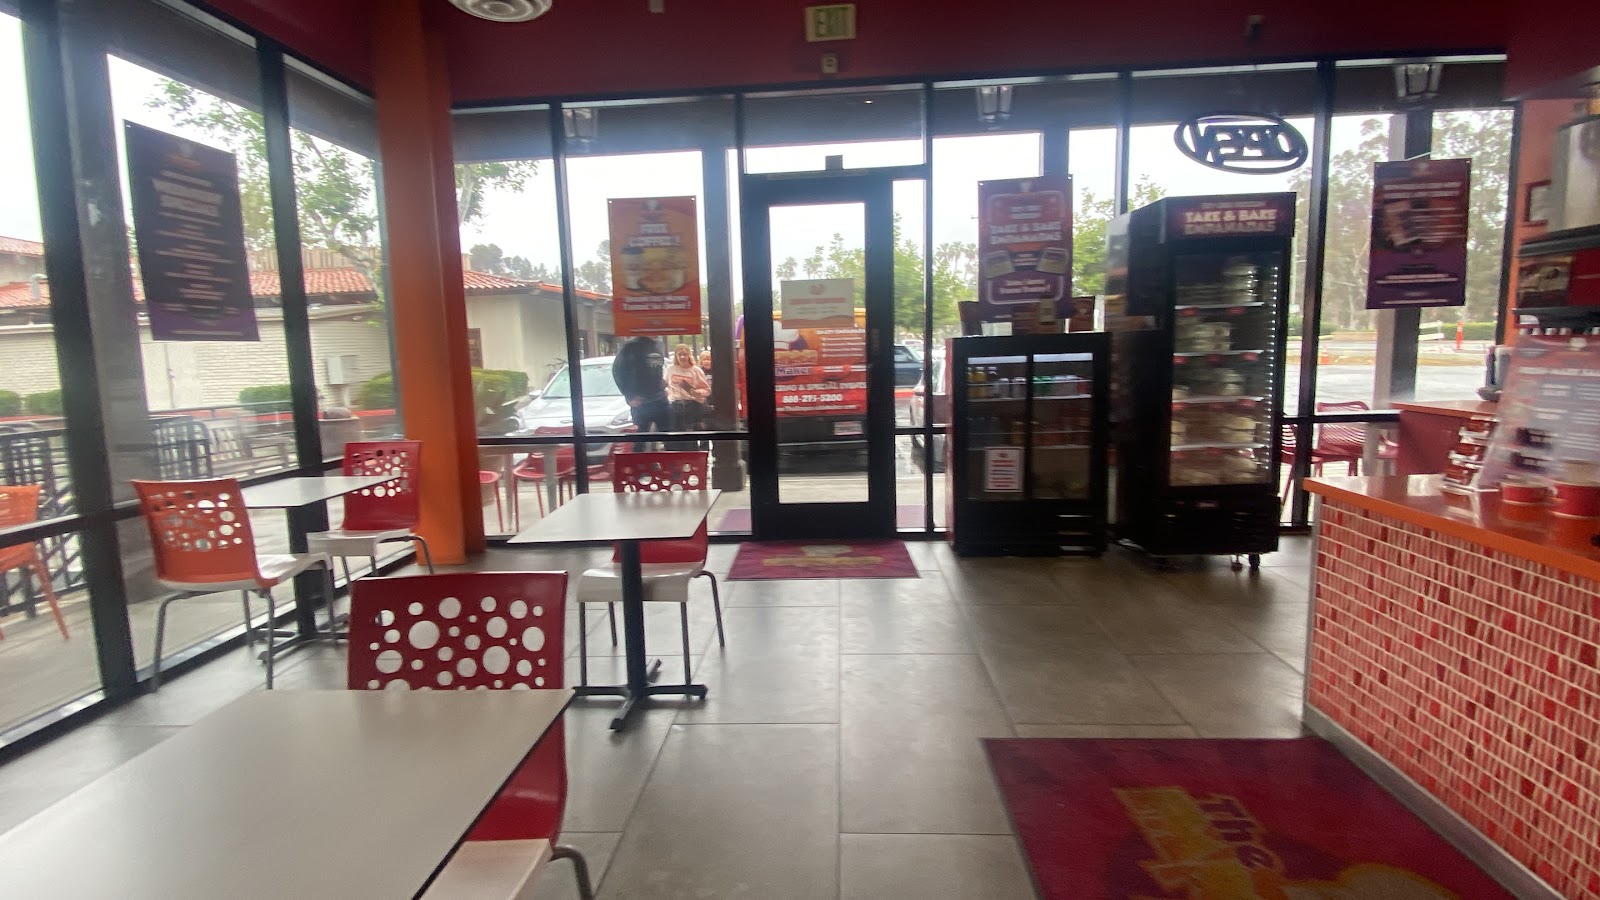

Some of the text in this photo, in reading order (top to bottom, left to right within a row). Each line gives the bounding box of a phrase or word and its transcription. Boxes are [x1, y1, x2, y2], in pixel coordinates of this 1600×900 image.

[815, 6, 849, 38] EXIT
[1185, 208, 1278, 224] TAKE & BAKE
[1197, 794, 1282, 872] The
